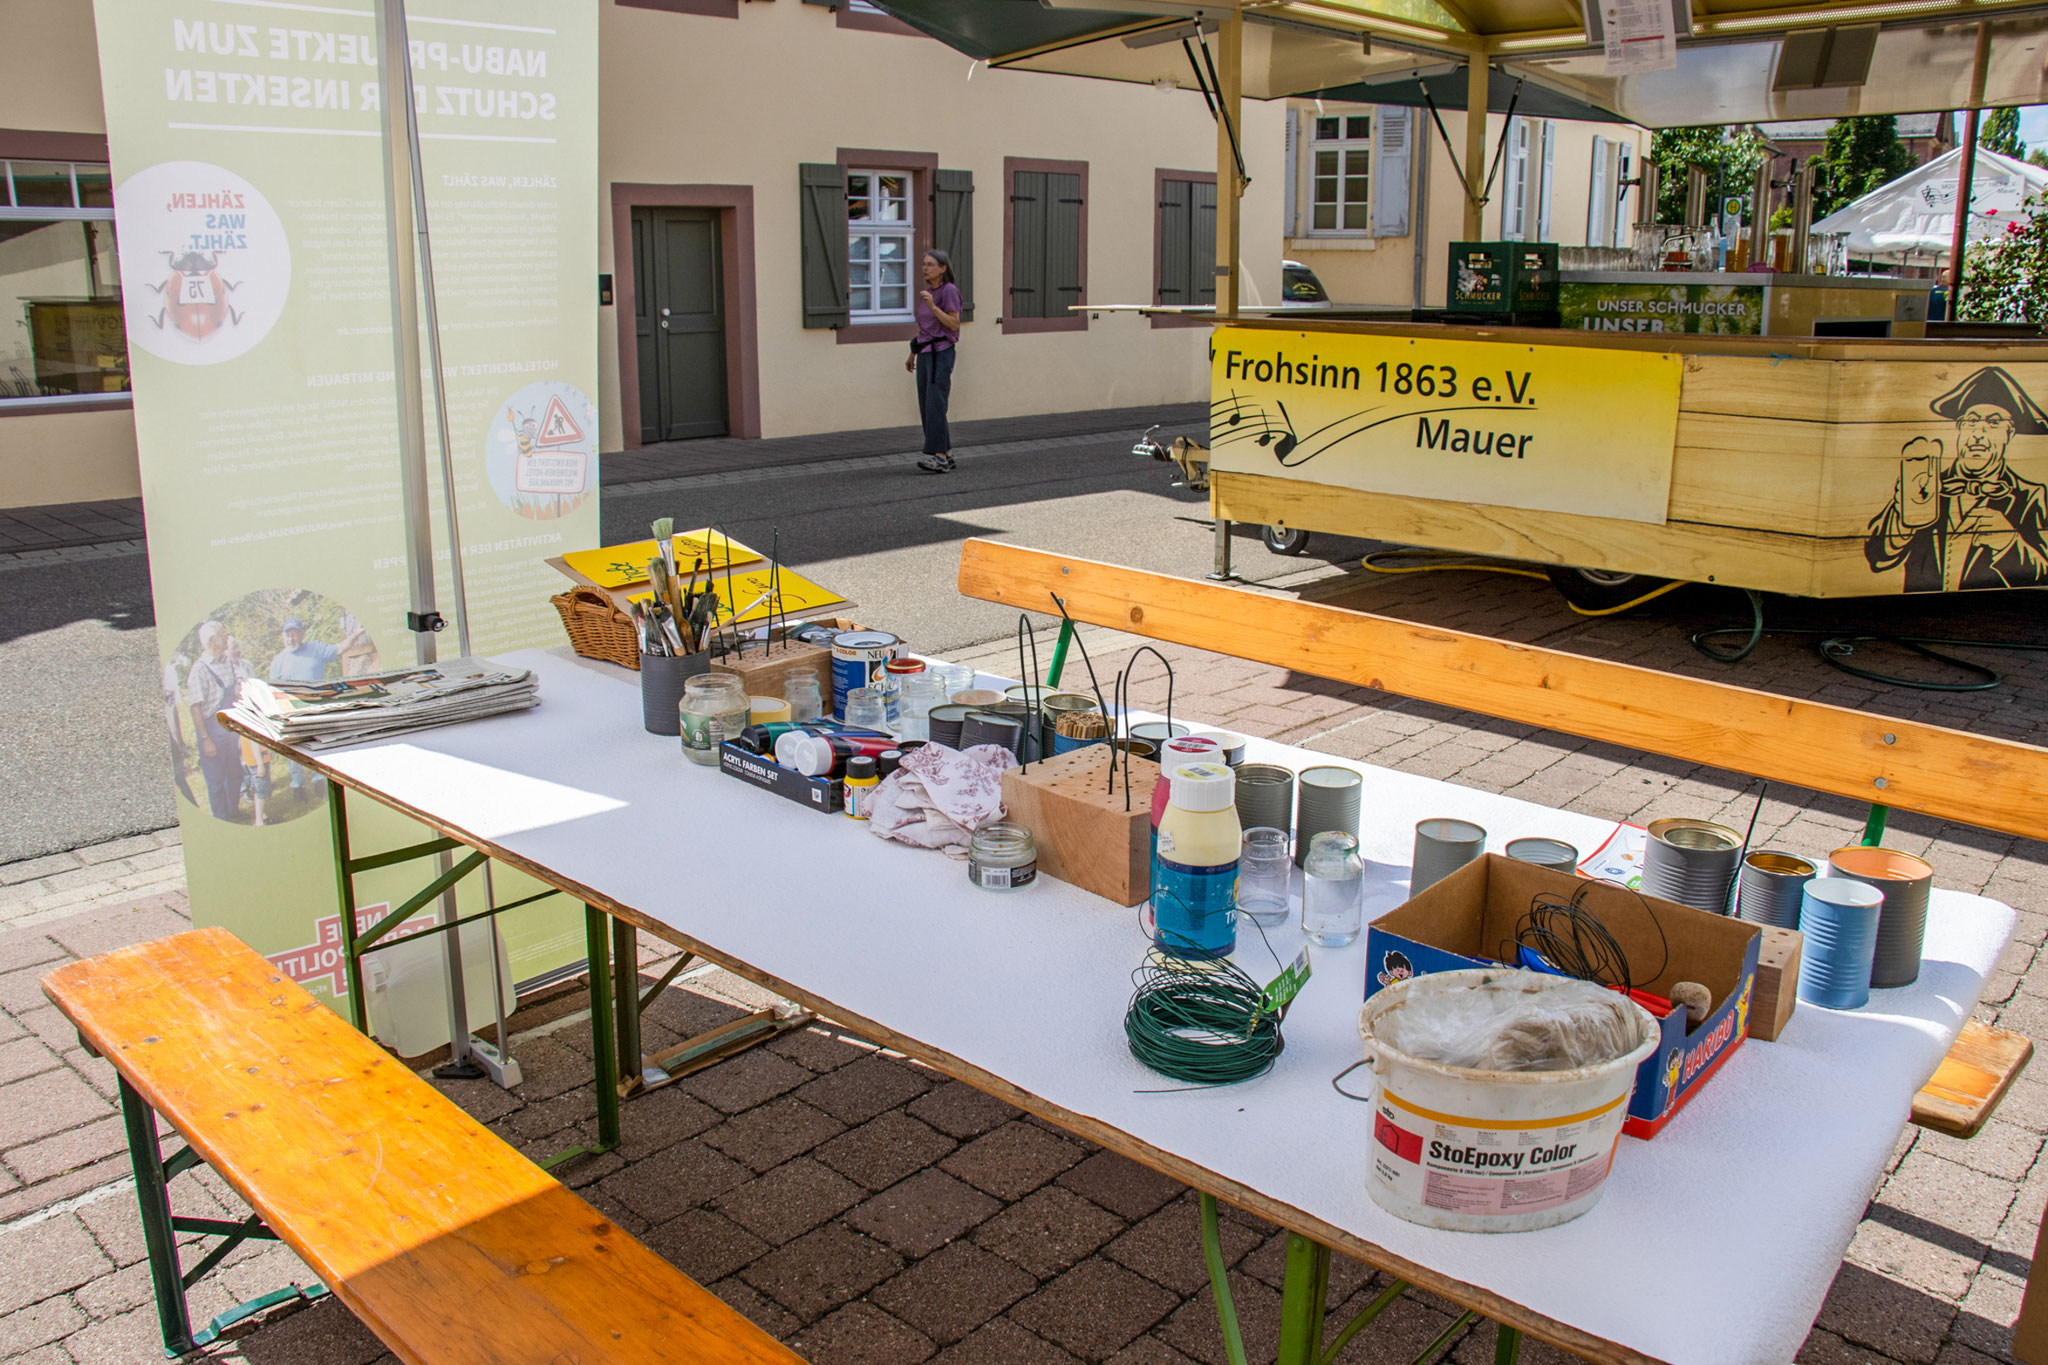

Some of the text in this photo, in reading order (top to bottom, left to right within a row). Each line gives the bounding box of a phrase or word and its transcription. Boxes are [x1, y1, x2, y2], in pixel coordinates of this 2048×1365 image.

[1596, 300, 1748, 316] UNSER SCHMUCKER
[1225, 350, 1536, 405] Frohsinn 1863 e.V.
[1415, 416, 1534, 459] Mauer
[723, 751, 779, 782] ACRYL FARBEN SET
[1682, 1009, 1735, 1084] HARIBO
[1428, 1140, 1526, 1170] StoEpoxy
[1529, 1144, 1578, 1166] Color
